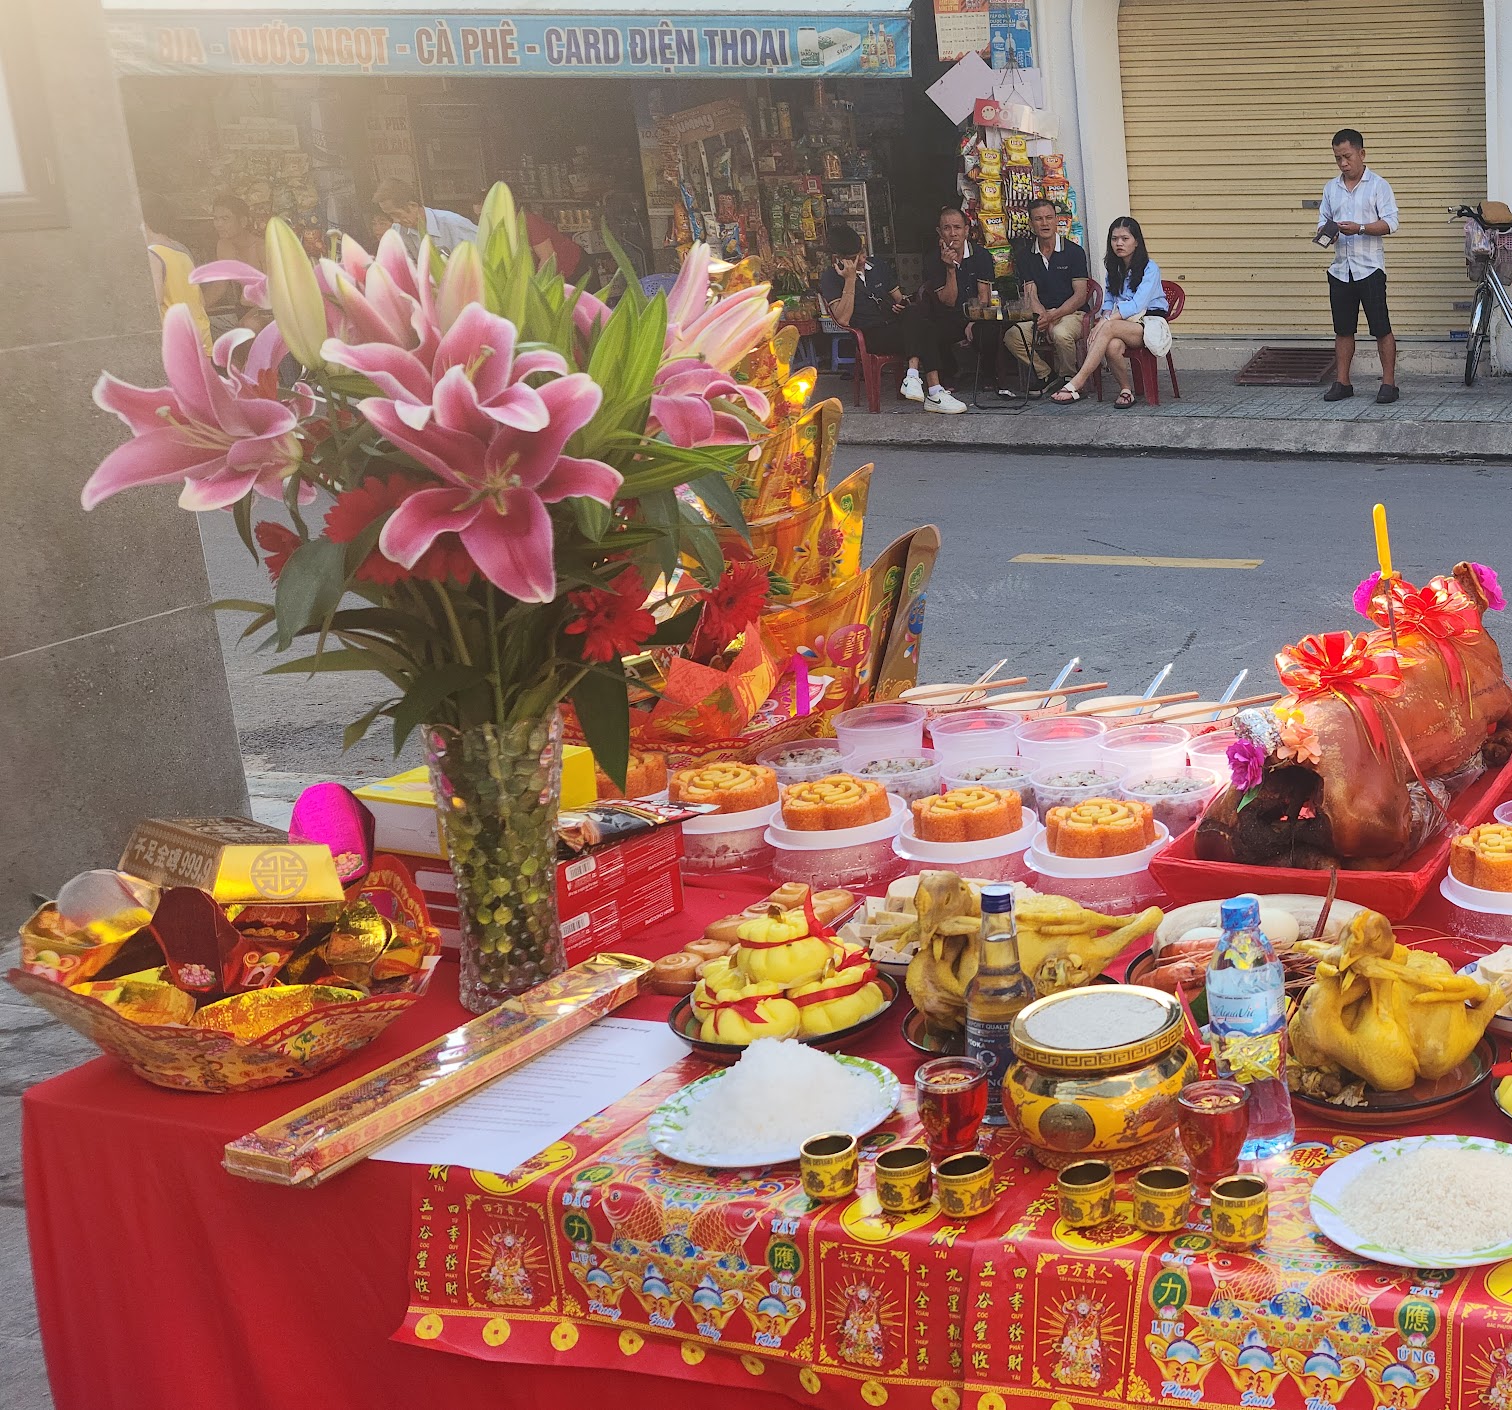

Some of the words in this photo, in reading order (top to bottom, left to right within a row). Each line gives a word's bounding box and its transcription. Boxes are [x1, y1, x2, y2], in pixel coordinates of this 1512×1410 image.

[153, 27, 206, 64] BIA
[228, 20, 309, 65] NƯỚC
[312, 26, 389, 73] NGỌT
[415, 19, 458, 65] CÀ
[460, 19, 520, 65] PHÊ
[544, 27, 623, 66] CARD
[628, 20, 699, 73] ĐIỆN
[702, 28, 792, 74] THOẠI
[178, 851, 213, 883] 999.9
[433, 1184, 445, 1193] TÀI
[419, 1198, 434, 1213] 五
[447, 1204, 460, 1214] 四
[562, 1191, 592, 1209] ĐẮC
[417, 1225, 434, 1240] 谷
[446, 1225, 460, 1243] 季
[771, 1217, 800, 1236] TẤT
[998, 1222, 1038, 1243] 財
[928, 1225, 967, 1248] 財
[571, 1250, 598, 1266] LỰC
[934, 1250, 948, 1260] TÀI
[1003, 1244, 1017, 1254] TÀI
[773, 1247, 795, 1270] 應
[837, 1250, 891, 1268] 北方貴人
[1161, 1251, 1197, 1266] ĐẮC
[915, 1264, 929, 1280] 十
[945, 1267, 963, 1282] 九
[978, 1260, 997, 1278] 五
[1013, 1267, 1028, 1279] 四
[414, 1278, 431, 1294] 收
[445, 1282, 459, 1296] 財
[769, 1280, 803, 1298] ỨNG
[1157, 1277, 1181, 1305] 力
[914, 1290, 930, 1309] 全
[974, 1291, 994, 1309] 谷
[1008, 1291, 1025, 1312] 季
[1404, 1304, 1430, 1333] 應
[913, 1321, 929, 1337] 十
[1150, 1319, 1185, 1338] LỰC
[971, 1350, 990, 1370] 收
[1007, 1353, 1024, 1372] 財
[1397, 1344, 1436, 1365] ỨNG
[1160, 1381, 1204, 1405] Phong
[1239, 1391, 1276, 1407] Sanh
